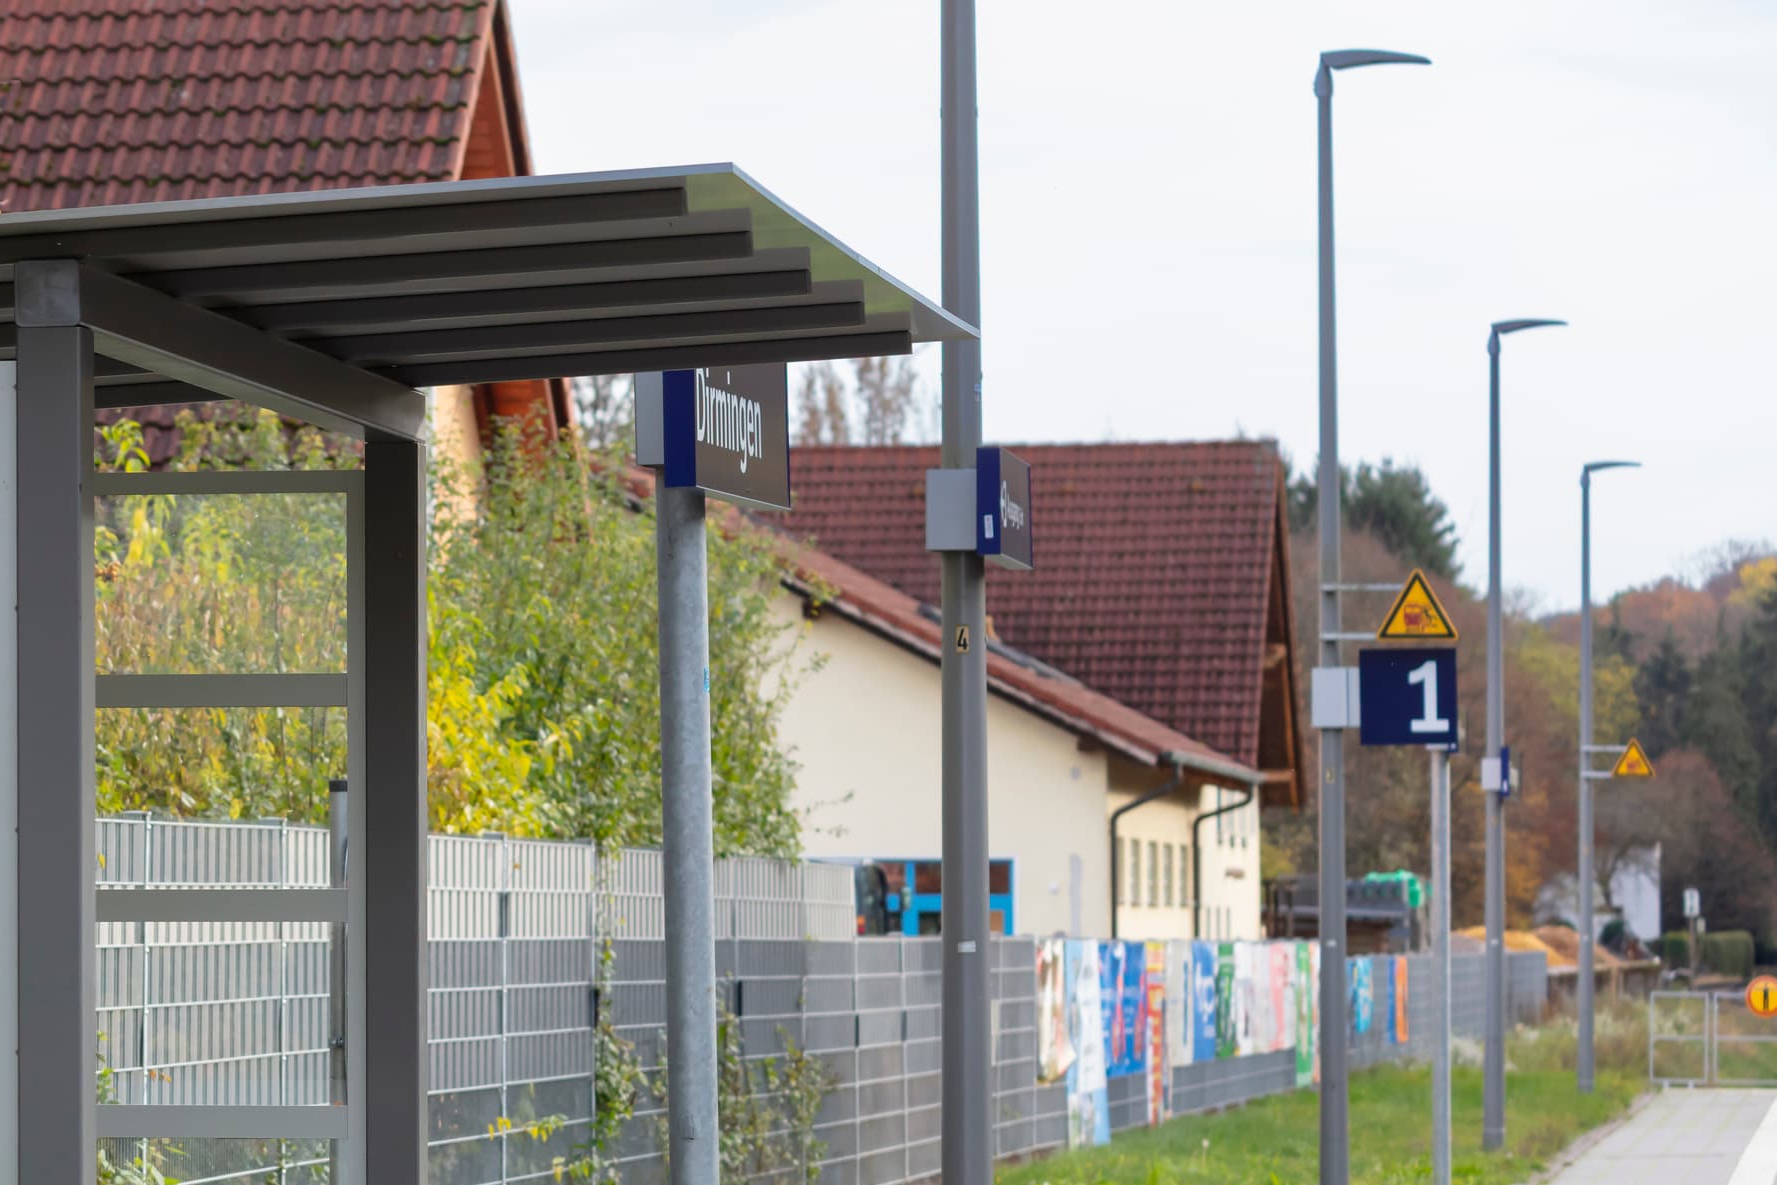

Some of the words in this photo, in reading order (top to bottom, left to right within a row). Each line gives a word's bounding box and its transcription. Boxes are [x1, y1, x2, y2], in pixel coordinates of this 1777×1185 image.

[696, 367, 762, 474] Dirmingen
[957, 627, 968, 651] 4
[1408, 660, 1450, 733] 1
